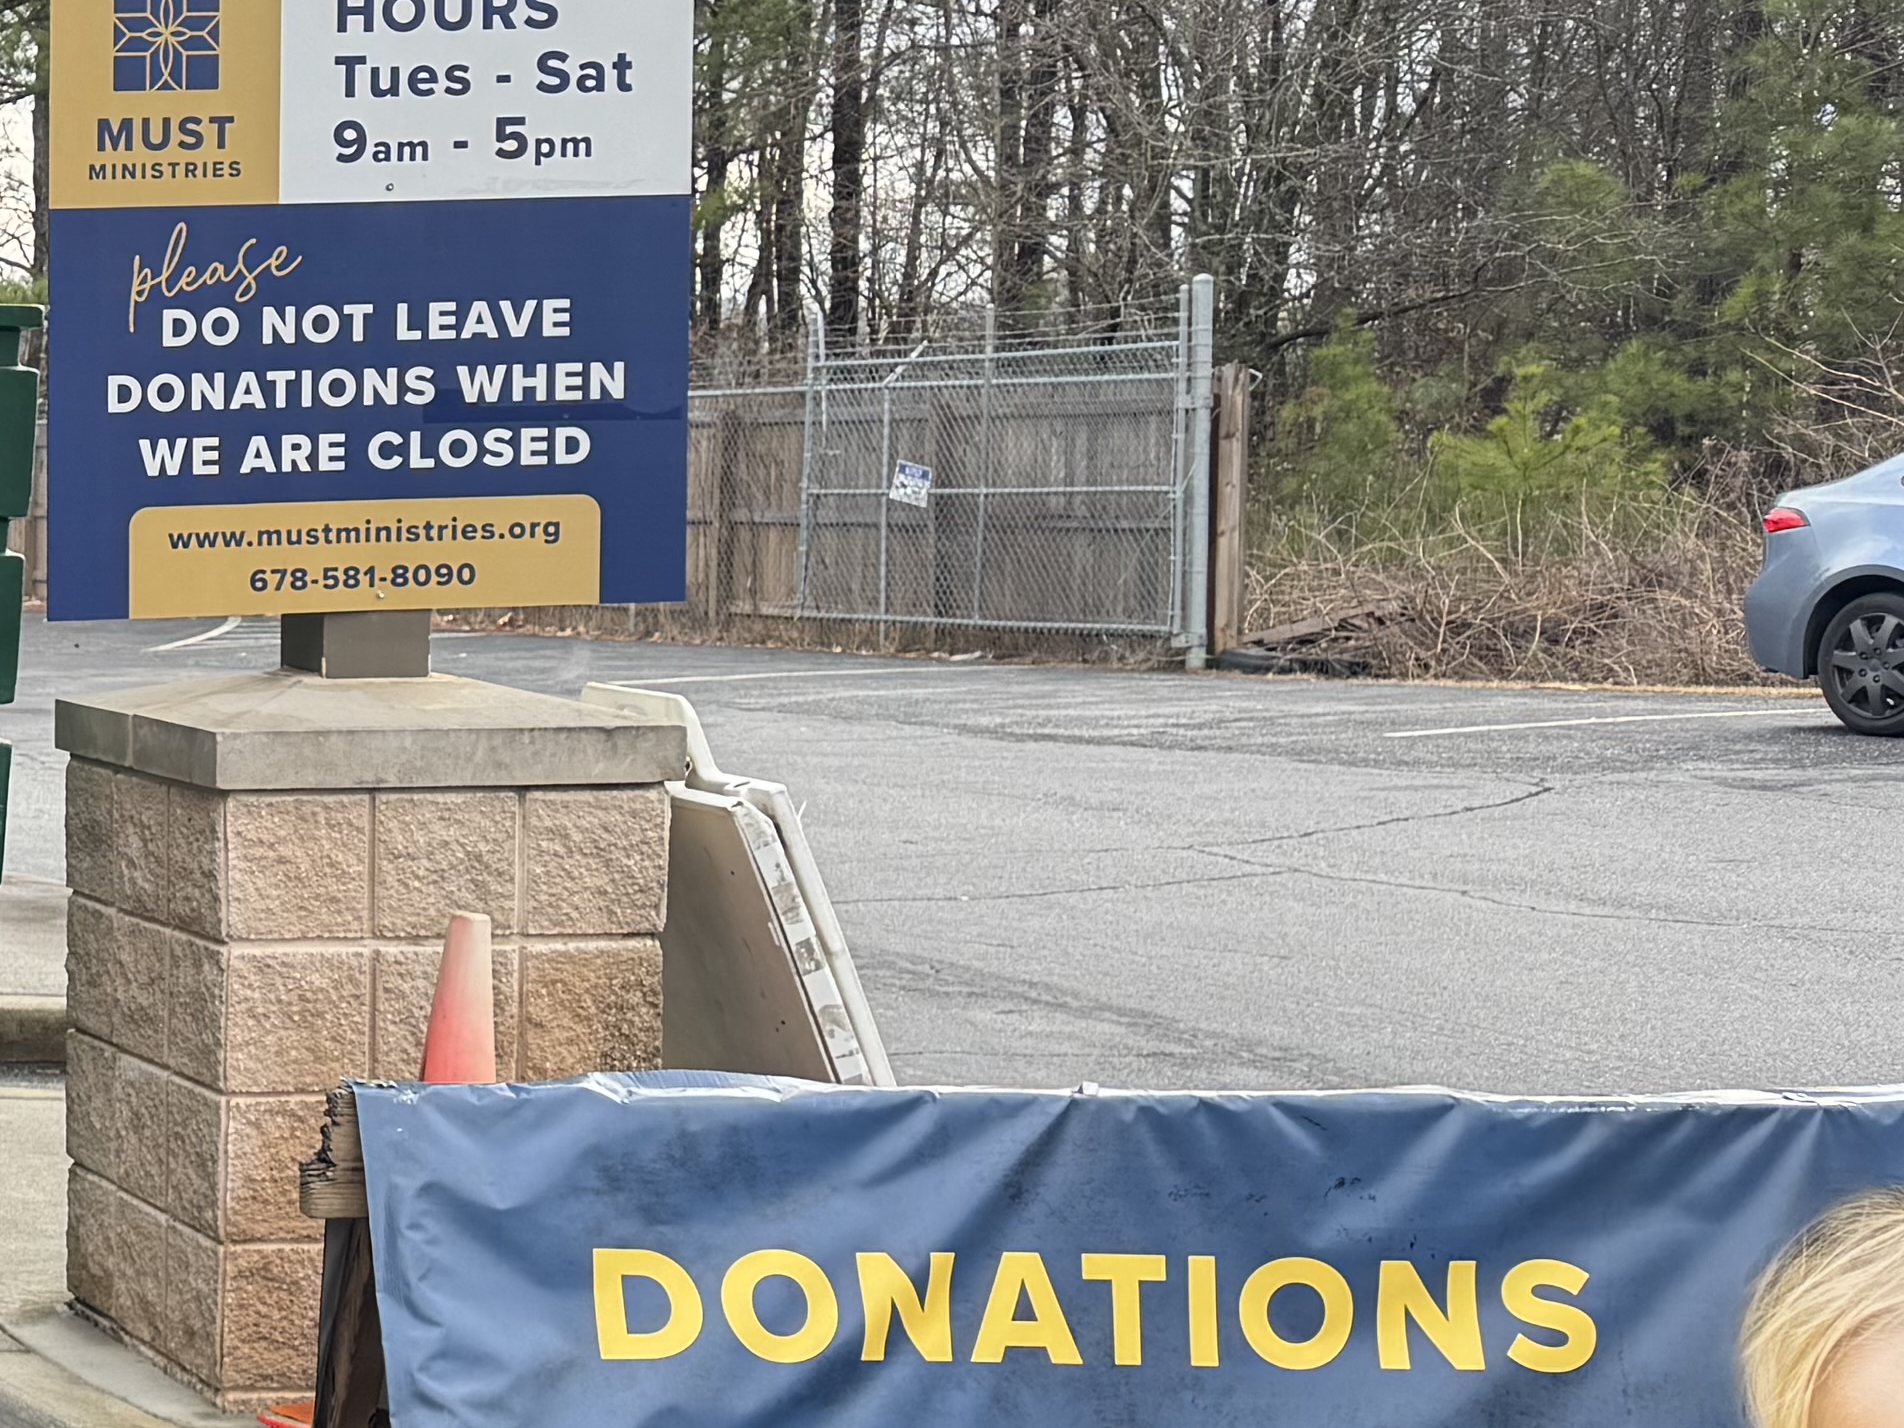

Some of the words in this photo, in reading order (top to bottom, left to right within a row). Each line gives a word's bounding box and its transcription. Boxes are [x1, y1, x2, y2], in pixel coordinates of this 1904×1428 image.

[335, 55, 471, 98] Tues
[495, 74, 511, 85] -
[535, 50, 633, 94] Sat
[97, 116, 235, 151] MUST
[333, 120, 430, 163] 9am
[453, 140, 469, 150] -
[495, 116, 593, 165] 5pm
[89, 160, 242, 181] MINISTRIES
[130, 223, 302, 333] please
[162, 306, 239, 347] DO
[262, 303, 373, 344] NOT
[396, 299, 572, 340] LEAVE
[107, 366, 435, 413] DONATIONS
[457, 361, 626, 403] WHEN
[139, 436, 221, 476] WE
[240, 433, 347, 473] ARE
[368, 426, 591, 469] CLOSED
[168, 518, 561, 550] www.mustministries.org
[249, 563, 476, 592] 678-581-8090
[592, 1246, 1598, 1374] DONATIONS
